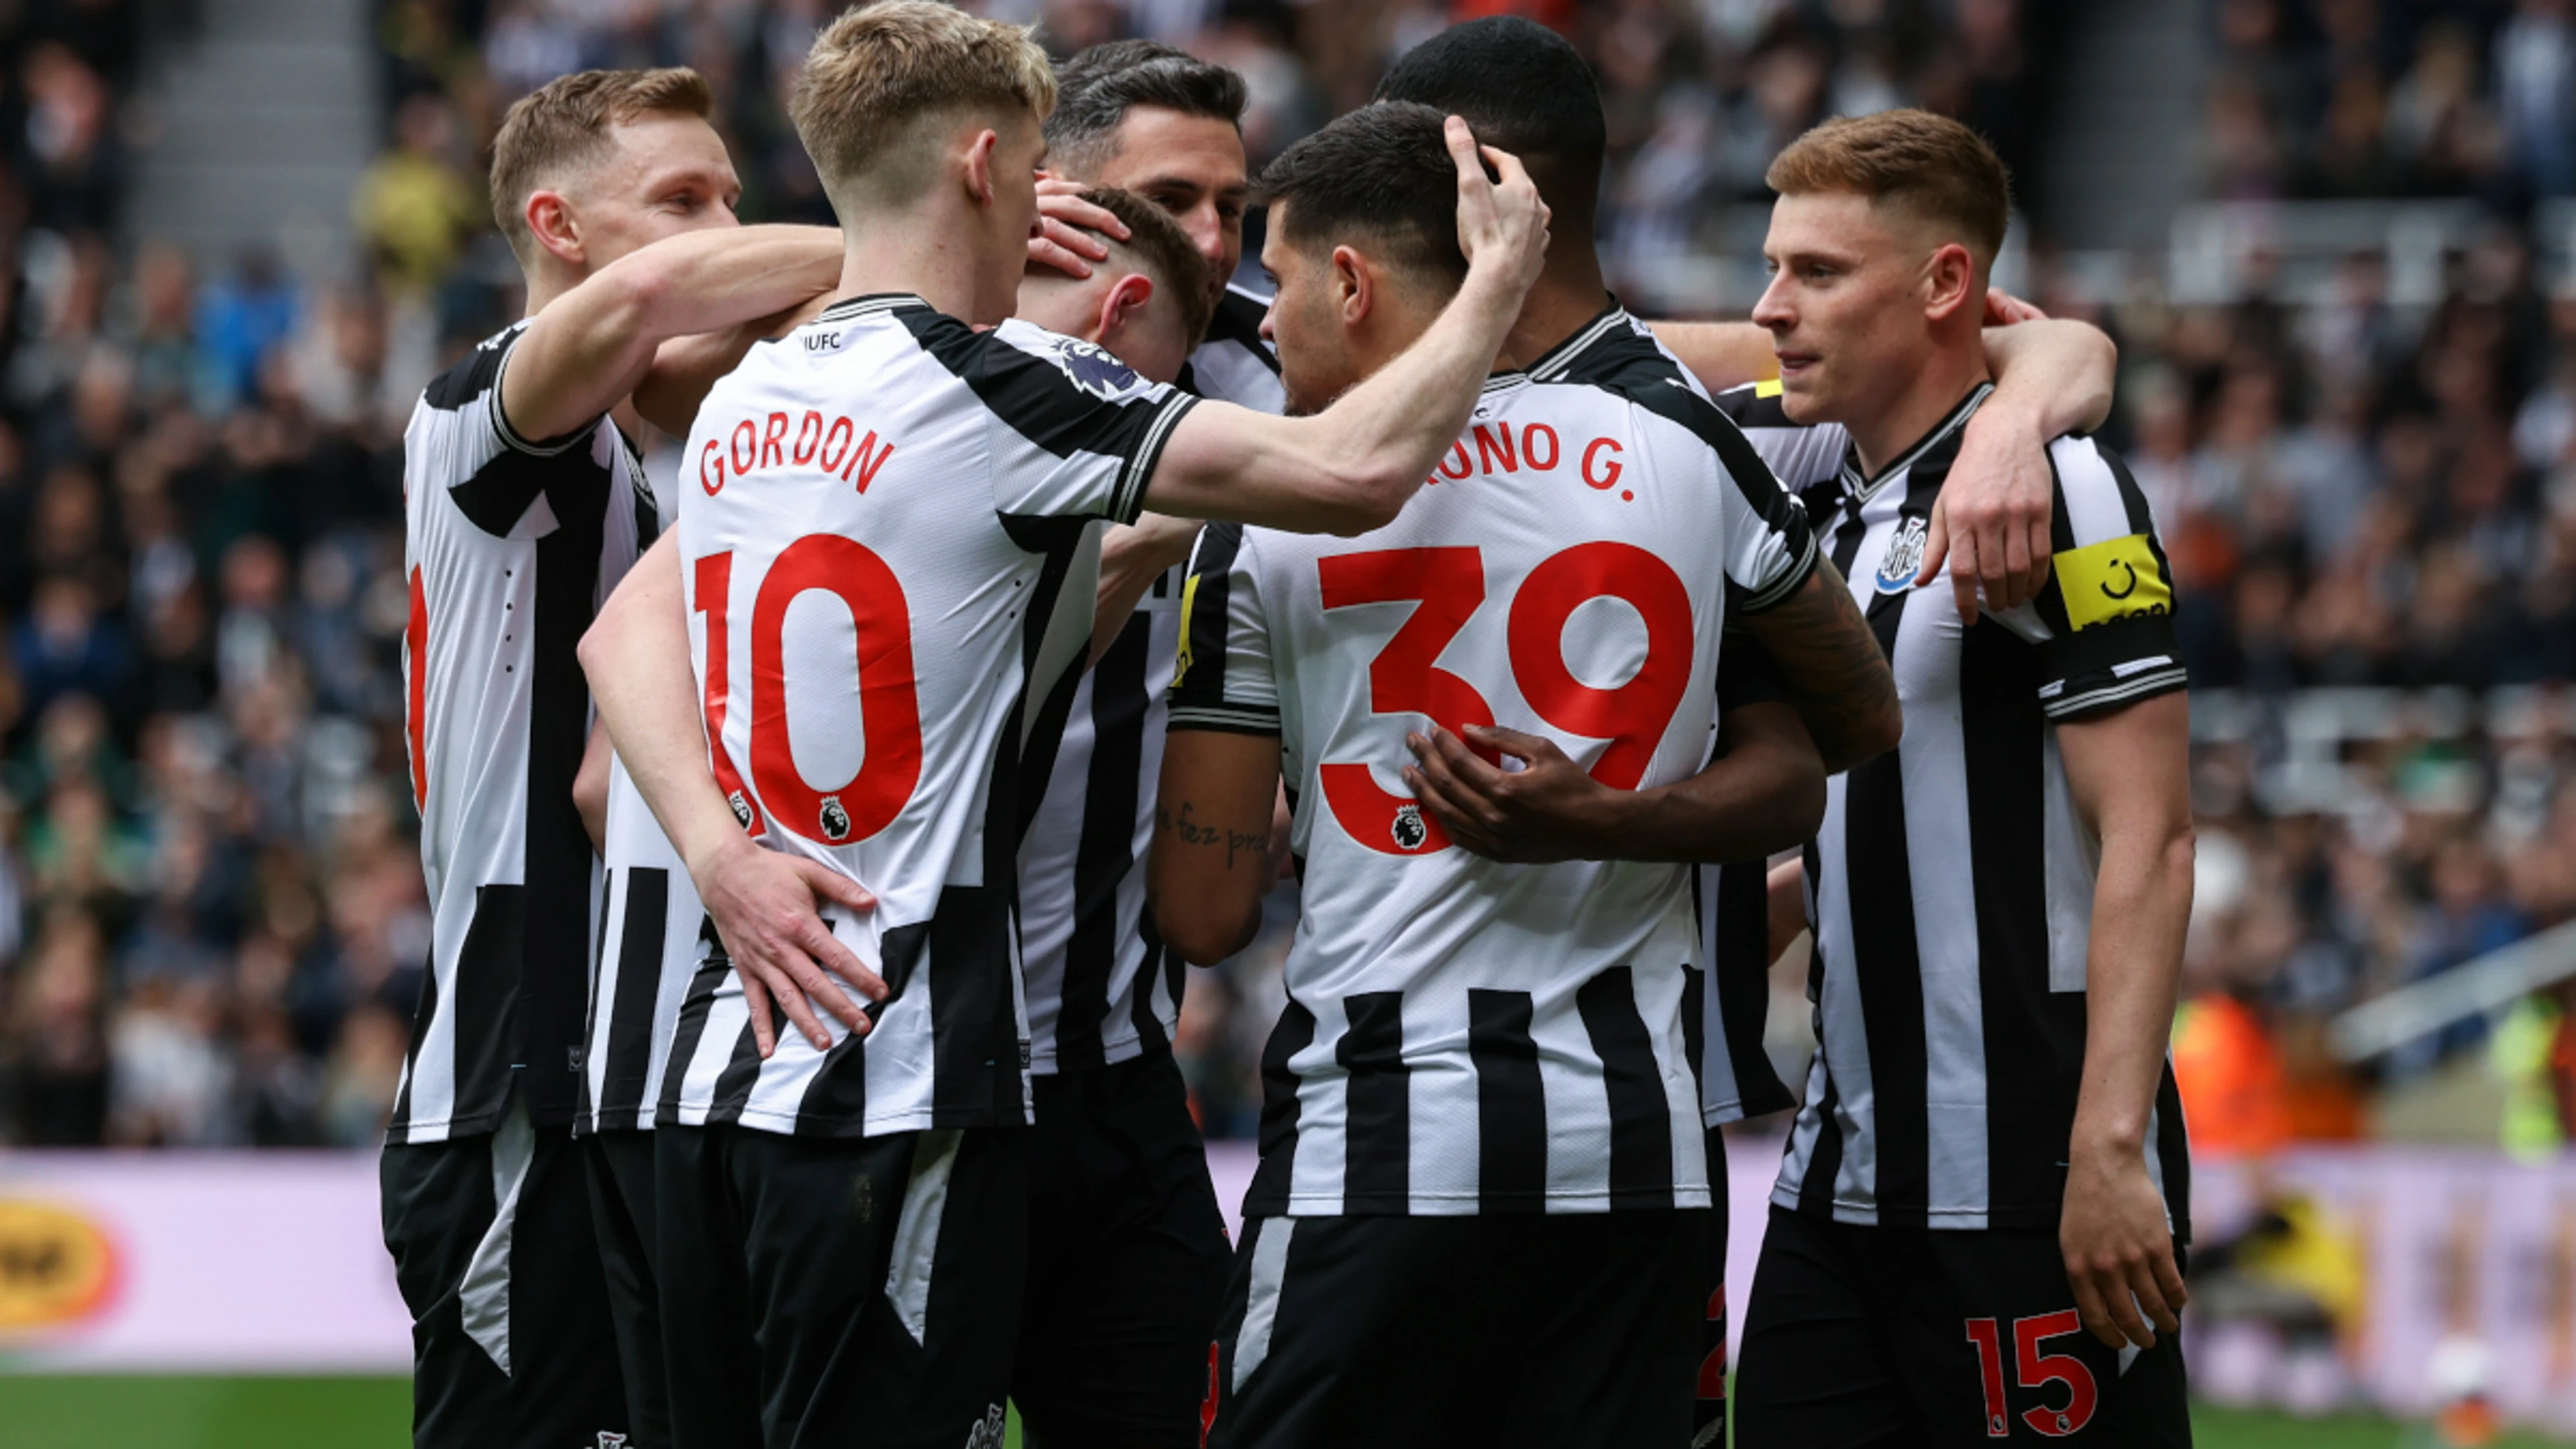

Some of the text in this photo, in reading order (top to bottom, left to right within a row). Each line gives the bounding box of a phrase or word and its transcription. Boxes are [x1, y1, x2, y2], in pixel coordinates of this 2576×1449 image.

[804, 332, 841, 351] UFC
[700, 410, 895, 496] GORDON
[1427, 421, 1634, 502] UNO G.
[694, 533, 924, 848] 10
[1317, 540, 1695, 856] 39
[1964, 1307, 2098, 1437] 15
